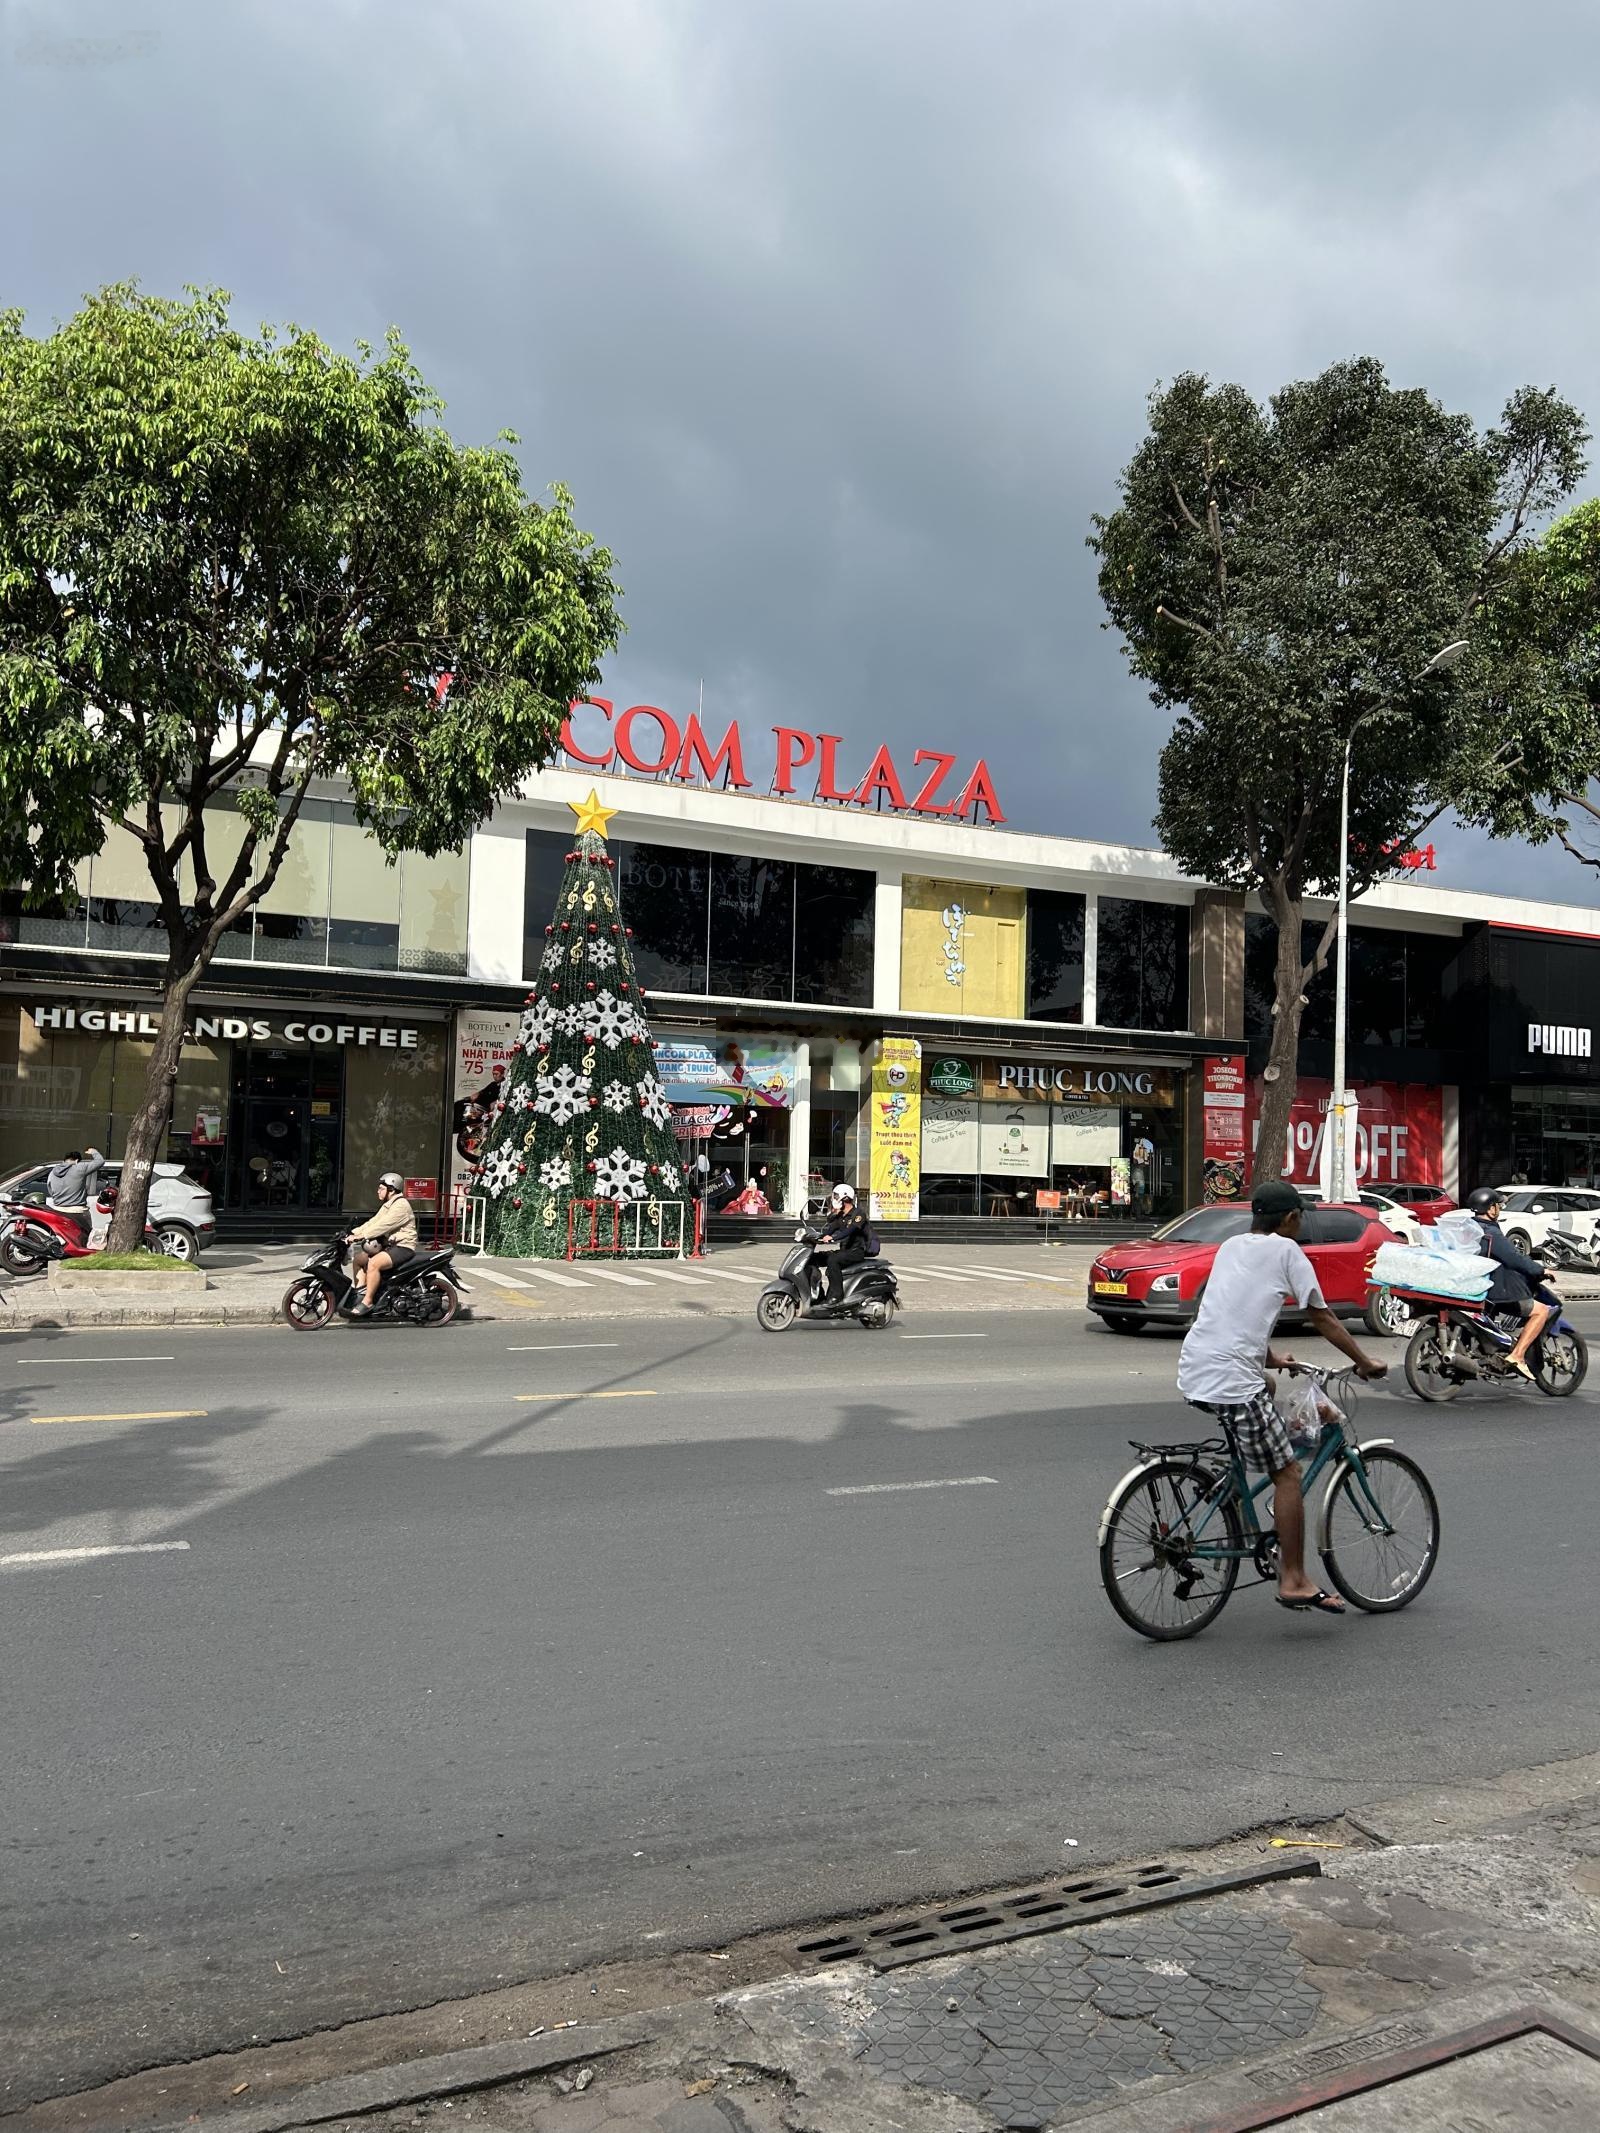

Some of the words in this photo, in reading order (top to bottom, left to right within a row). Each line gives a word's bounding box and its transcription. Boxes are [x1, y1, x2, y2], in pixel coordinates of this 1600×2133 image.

[772, 726, 1008, 823] PLAZA
[33, 1006, 271, 1042] HIGHLNDS
[283, 1021, 419, 1048] COFFEE
[1527, 1023, 1592, 1058] PUMA
[462, 1047, 489, 1061] NHẬT
[654, 1050, 686, 1060] INCOM
[464, 1061, 484, 1075] 75
[658, 1063, 685, 1072] UANG
[686, 1063, 716, 1073] TRUNG
[929, 1078, 953, 1087] PHUC
[953, 1079, 973, 1088] LONG
[999, 1065, 1073, 1092] PHUC
[1083, 1070, 1153, 1095] LONG
[673, 1115, 712, 1126] BLACK
[922, 1112, 944, 1127] HUC
[944, 1106, 971, 1119] LONG
[1063, 1108, 1088, 1123] PHUC
[930, 1135, 949, 1144] Coffee
[1355, 1124, 1409, 1179] OFF
[414, 1179, 428, 1188] CẤM
